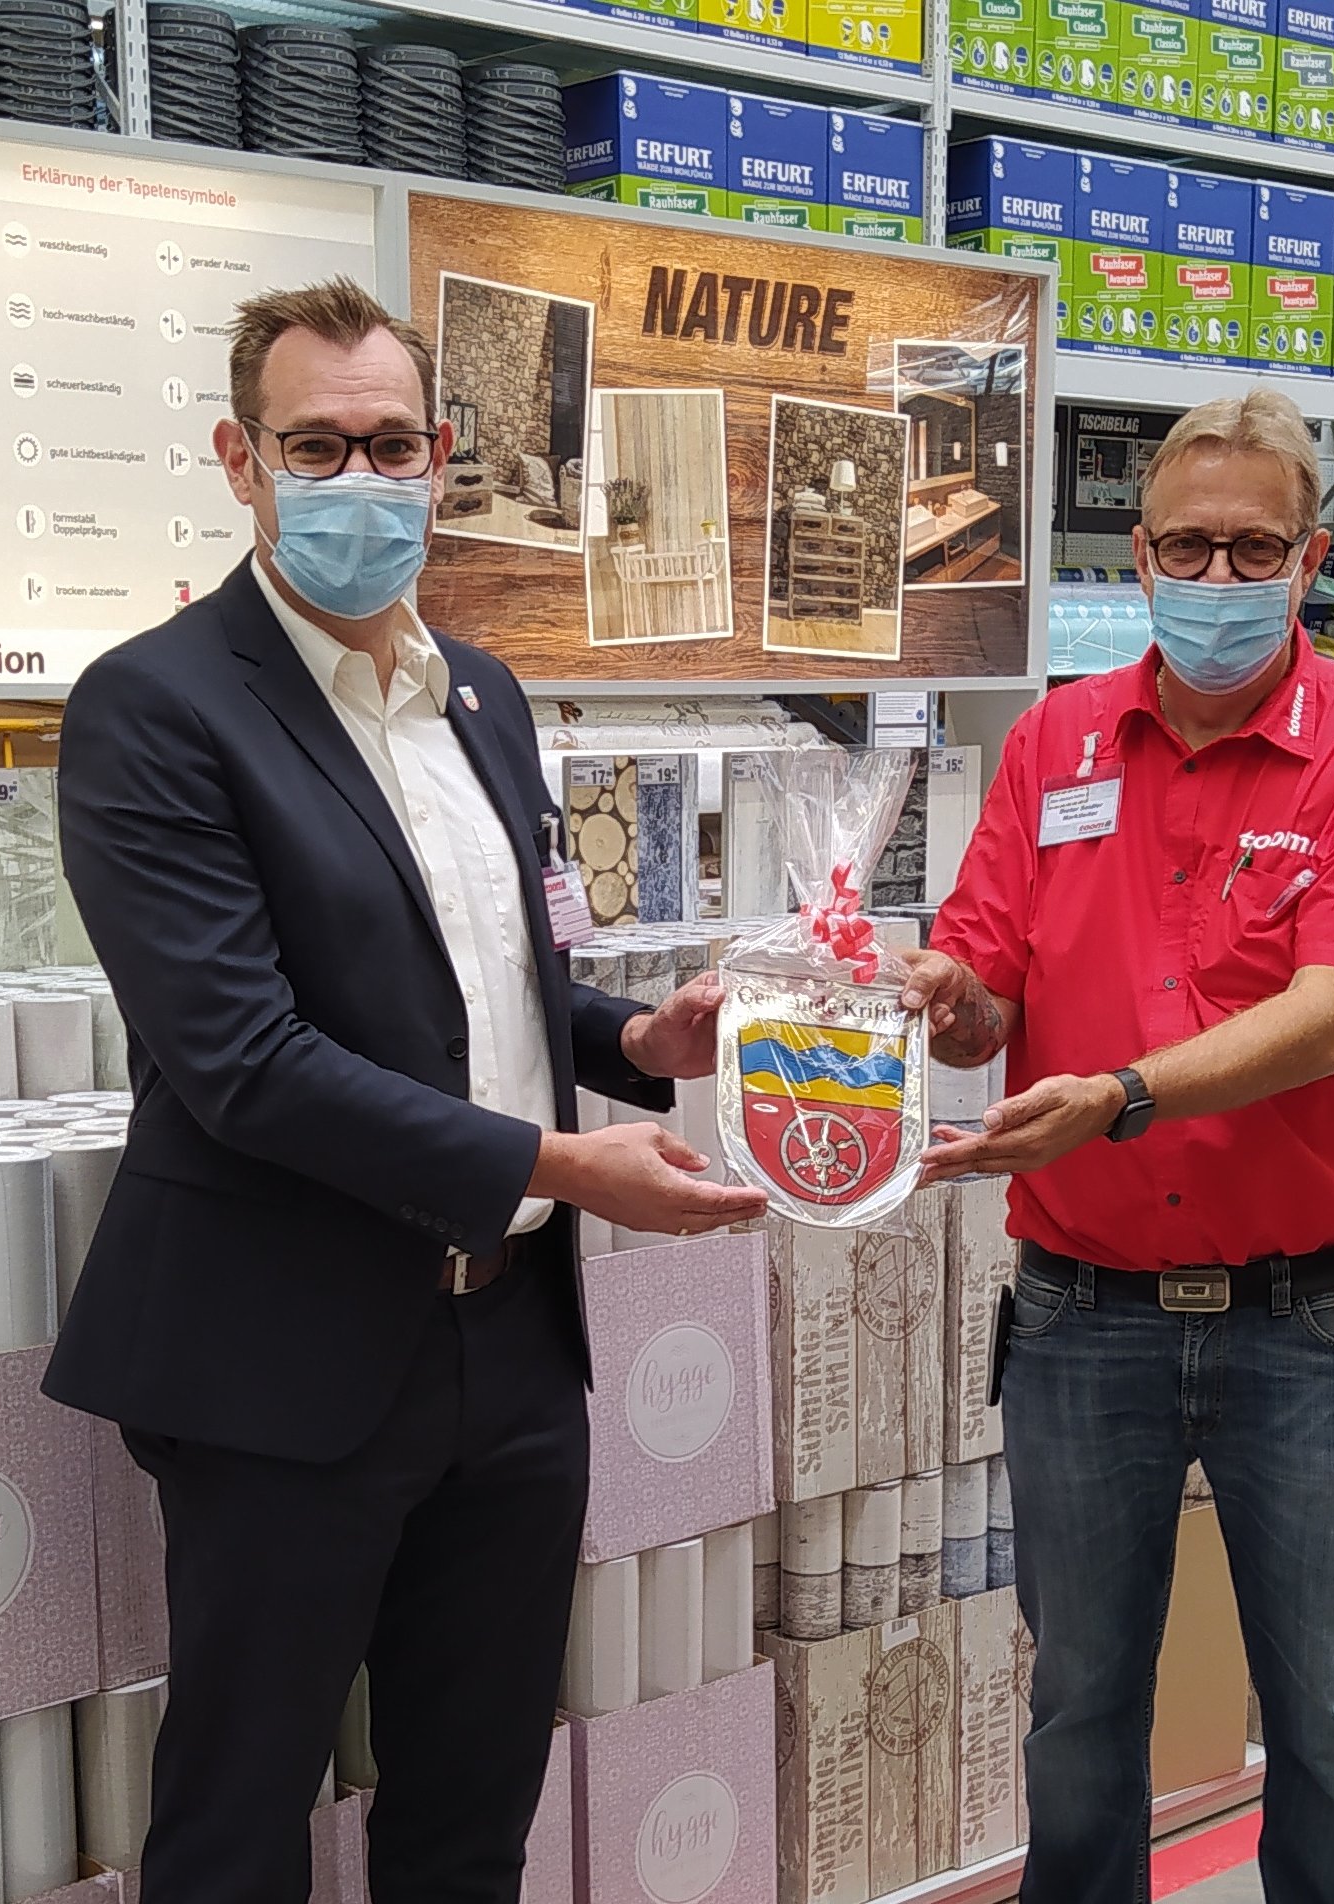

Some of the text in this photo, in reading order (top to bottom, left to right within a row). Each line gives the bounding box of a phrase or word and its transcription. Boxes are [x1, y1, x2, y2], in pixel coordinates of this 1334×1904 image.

[1287, 7, 1334, 33] ERFURT
[567, 139, 613, 162] ERFURT
[636, 138, 713, 170] ERFURT
[741, 156, 814, 186] ERFURT
[22, 164, 237, 208] Erklärung der Tapetensymbole
[842, 171, 910, 199] ERFURT
[648, 195, 697, 211] Rauhfaser
[1002, 195, 1063, 222] ERFURT
[753, 211, 799, 226] Rauhfaser
[1091, 209, 1150, 235] ERFURT
[853, 225, 896, 238] Rauhfaser
[1177, 223, 1235, 247] ERFURT
[39, 239, 108, 258] waschbeständig
[1268, 235, 1322, 259] ERFURT
[189, 257, 251, 272] gerader Ansatz
[42, 308, 136, 329] hoch-waschbeständig
[642, 265, 856, 357] NATURE
[46, 379, 122, 396] scheuerbeständig
[1078, 413, 1140, 434] TISCHBELAG
[52, 511, 96, 524] formstabil
[53, 524, 118, 538] Doppelprägung
[1287, 681, 1305, 737] toom
[1238, 830, 1310, 855] toom
[643, 1360, 716, 1413] hygge
